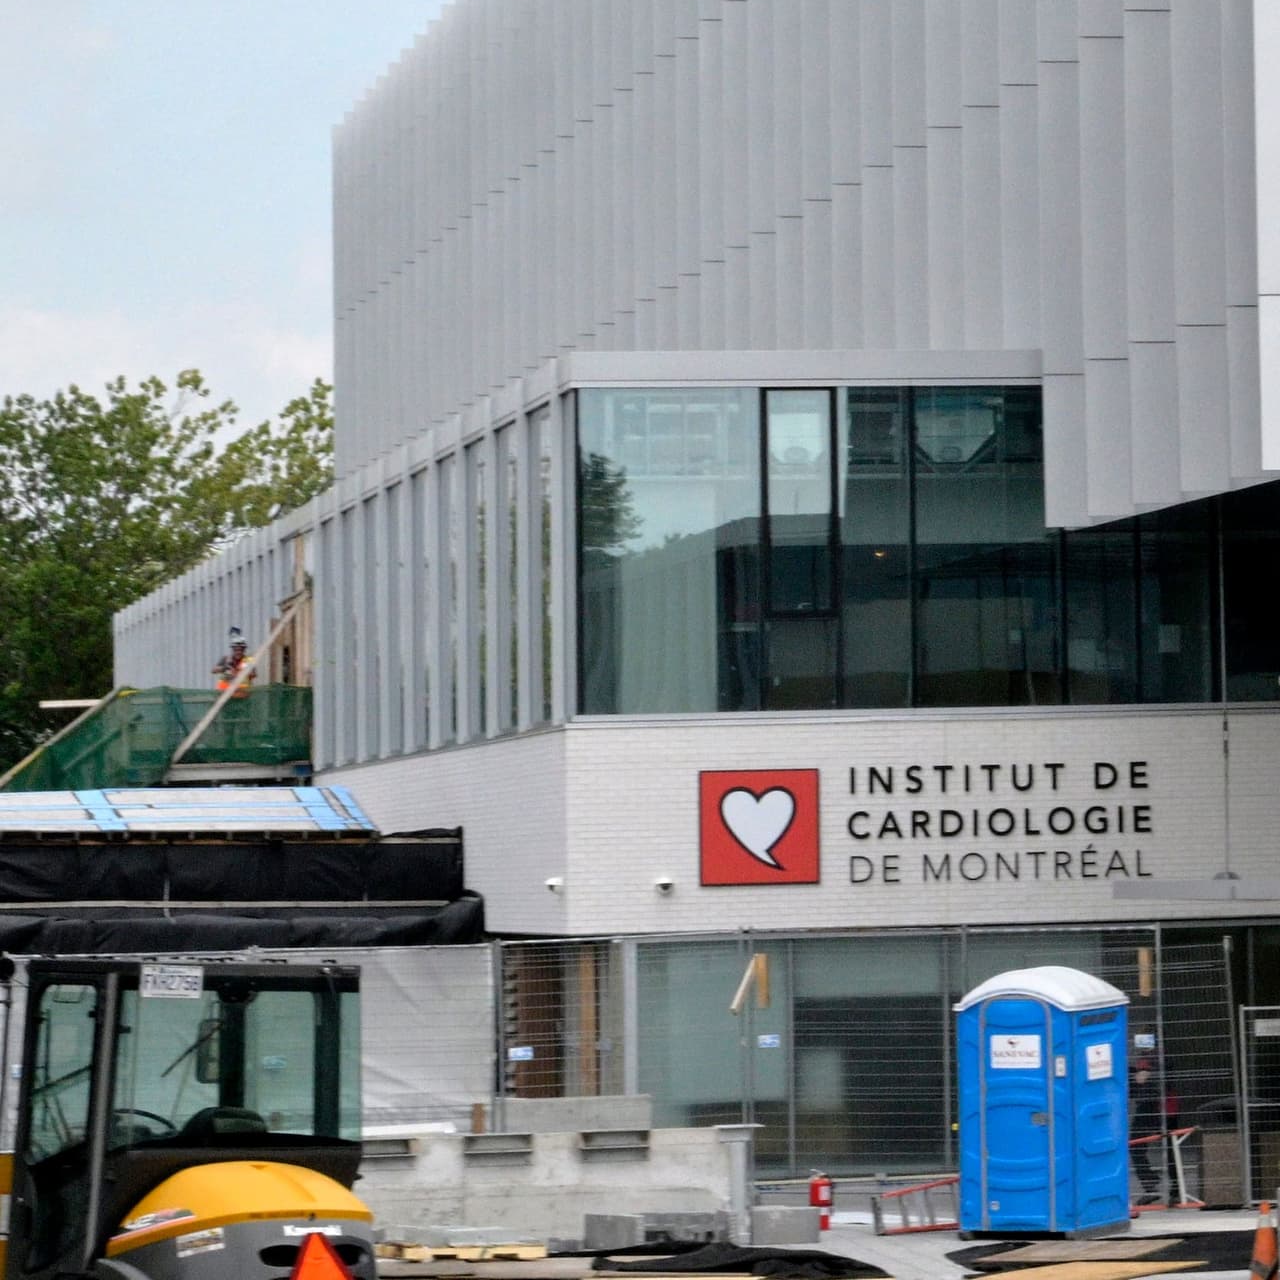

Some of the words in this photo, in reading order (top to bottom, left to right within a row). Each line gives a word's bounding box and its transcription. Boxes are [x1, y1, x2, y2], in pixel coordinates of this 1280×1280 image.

[850, 763, 1065, 795] INSTITUT
[1093, 761, 1149, 790] DE
[847, 805, 1152, 839] CARDIOLOGIE
[850, 854, 901, 884] DE
[922, 843, 1153, 882] MONTRÉAL
